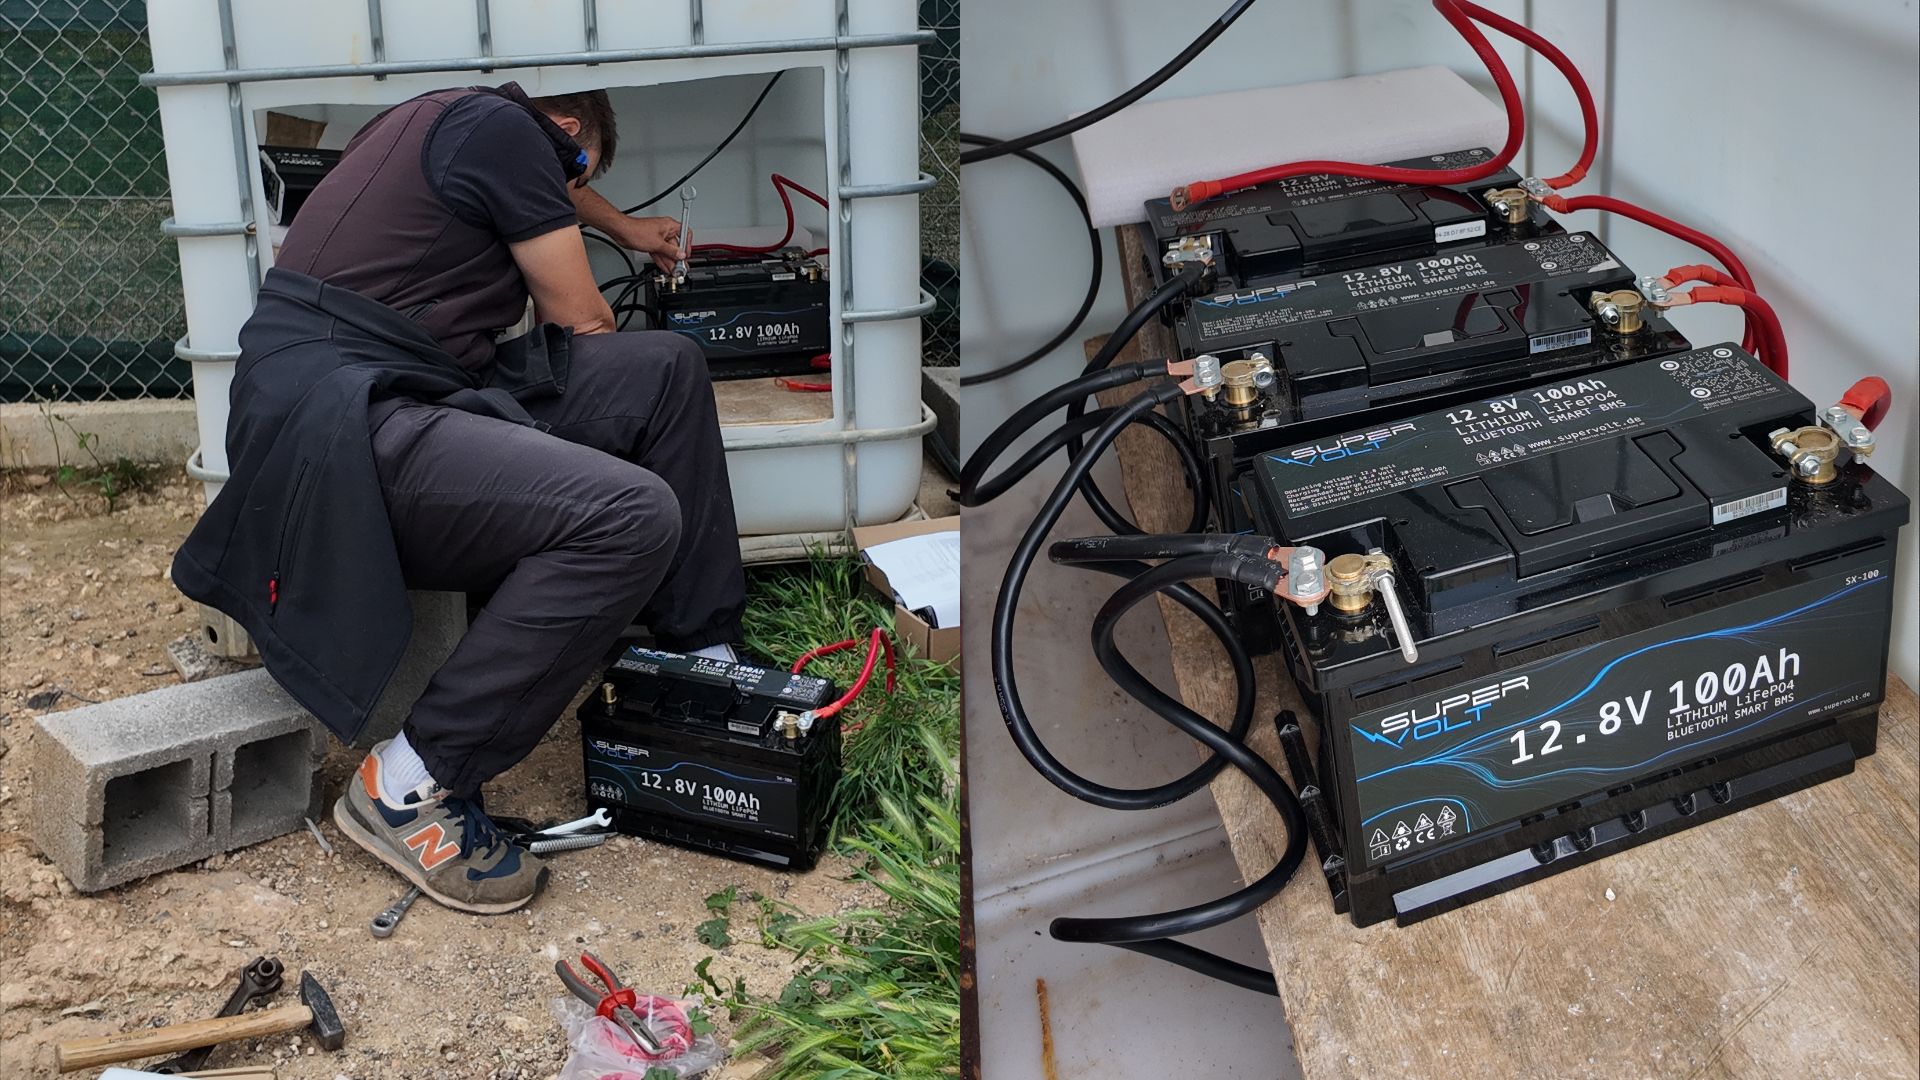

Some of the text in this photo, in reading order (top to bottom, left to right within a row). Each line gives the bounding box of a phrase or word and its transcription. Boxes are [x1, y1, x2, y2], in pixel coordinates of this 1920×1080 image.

[1279, 173, 1329, 188] 12.8V
[1282, 180, 1337, 193] LITHIUM
[1286, 185, 1342, 198] BLUETOOTH
[1342, 254, 1477, 284] 12.8V 100Ah
[1347, 262, 1484, 291] LITHIUM LiFePO4
[1351, 281, 1417, 298] BLUETOOTH
[1422, 273, 1459, 285] SMART
[1465, 268, 1488, 278] BMS
[1195, 290, 1291, 309] VOLT
[1214, 280, 1318, 304] SUPER
[1400, 280, 1496, 302] www.supervolt.de
[667, 314, 704, 325] VOLT
[673, 310, 717, 320] SUPER
[709, 322, 800, 341] 12.8V 100Ah
[1446, 378, 1607, 426] 12.8V 100Ah
[1456, 390, 1618, 437] LITHIUM LiFePO4
[1463, 398, 1627, 446] BLUETOOTH SMART BMS
[1528, 416, 1643, 450] www.supervolt.de
[1267, 438, 1387, 468] VOLT
[1291, 422, 1417, 460] SUPER
[1284, 482, 1322, 496] Operating
[1324, 474, 1357, 486] Voltage:
[1380, 463, 1396, 472] Volt
[1288, 490, 1334, 504] Recommended
[1336, 481, 1362, 493] Charge
[1845, 569, 1879, 586] SX-100
[637, 647, 687, 661] SUPER
[696, 658, 766, 676] 12.8V 100Ah
[1380, 675, 1530, 735] SUPER
[1509, 647, 1801, 765] 12.8V 100Ah
[1666, 678, 1796, 729] LITHIUM LiFePO4
[1667, 692, 1796, 742] BLUETOOTH SMART BMS
[1807, 690, 1872, 717] www.supervolt.de
[1350, 703, 1492, 750] VOLT
[587, 737, 637, 761] VOLT
[595, 740, 650, 758] SUPER
[640, 771, 760, 811] 12.8V 100Ah
[702, 799, 759, 816] LITHIUM LiFePO4
[403, 821, 462, 871] N
